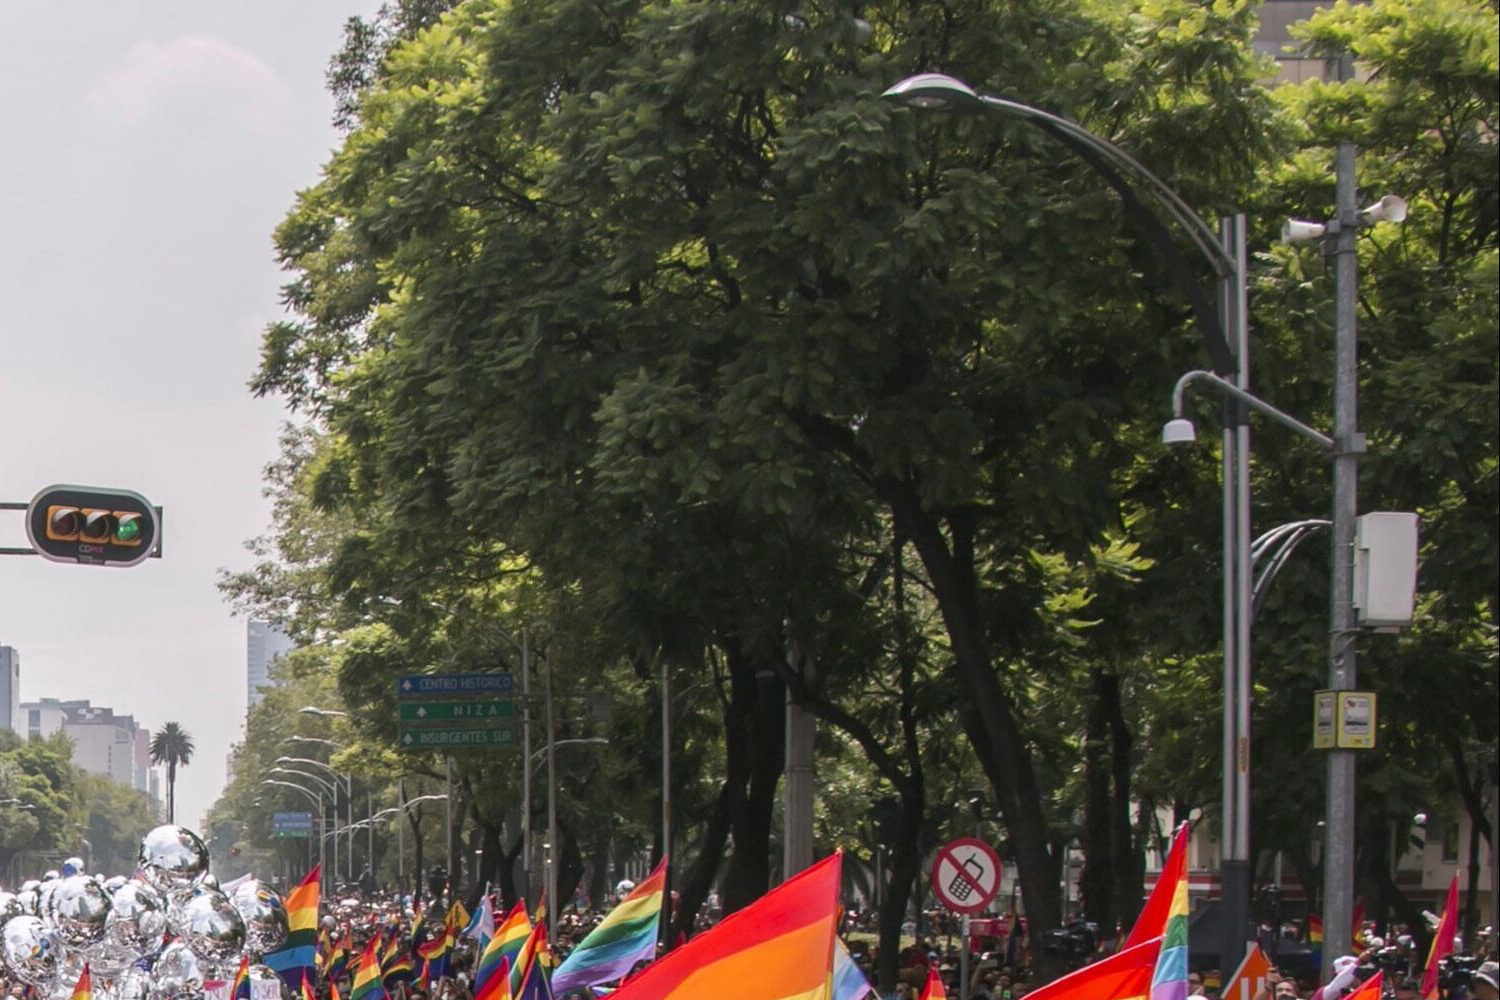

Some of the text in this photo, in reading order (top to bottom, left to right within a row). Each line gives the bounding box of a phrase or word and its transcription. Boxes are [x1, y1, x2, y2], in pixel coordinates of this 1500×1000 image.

[420, 677, 457, 689] CENTRO
[420, 730, 512, 744] INSURGENTES SUR
